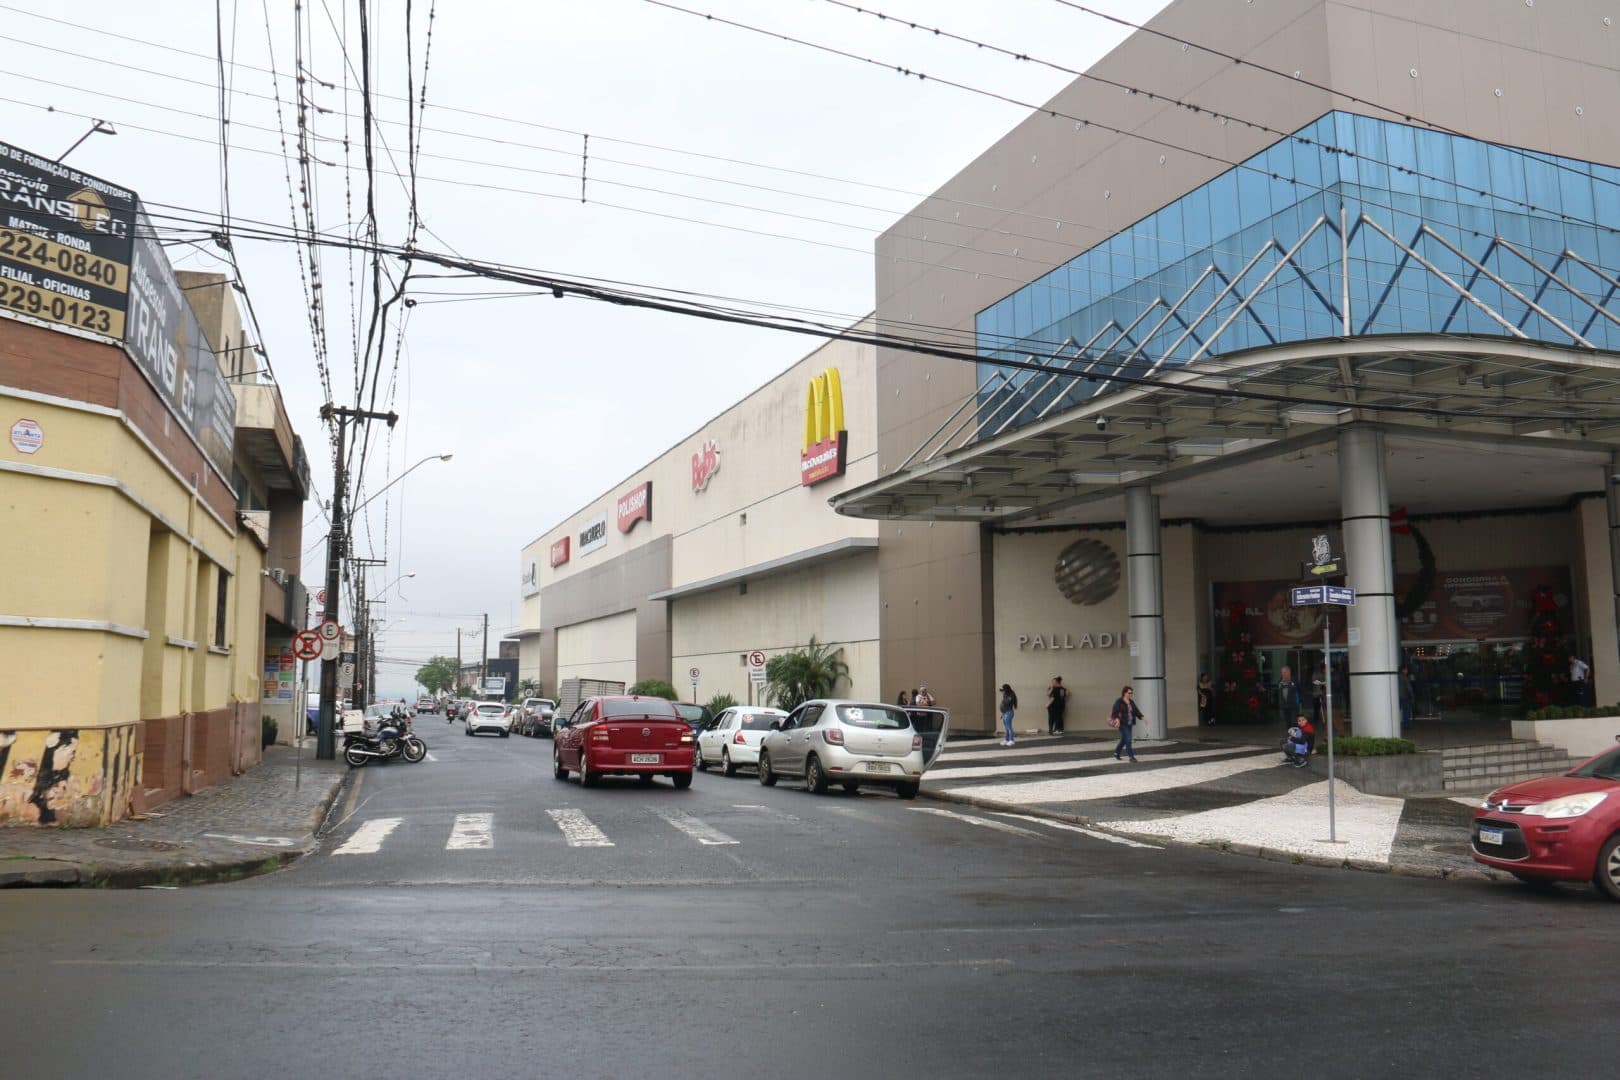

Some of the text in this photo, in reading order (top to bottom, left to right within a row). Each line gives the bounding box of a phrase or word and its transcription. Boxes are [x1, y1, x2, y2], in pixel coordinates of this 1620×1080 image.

[10, 149, 23, 162] DE
[24, 154, 69, 179] FORMAÇÃO
[70, 172, 82, 184] DE
[82, 175, 132, 202] CONDUTORES
[8, 216, 50, 239] MATRIZ
[56, 232, 92, 253] RONDA
[0, 230, 117, 286] 224-0840
[1, 265, 35, 285] FILIAL
[43, 278, 91, 301] OFICINAS
[619, 489, 646, 520] POLISHOP
[326, 625, 334, 636] E
[1018, 632, 1130, 649] PALLADI
